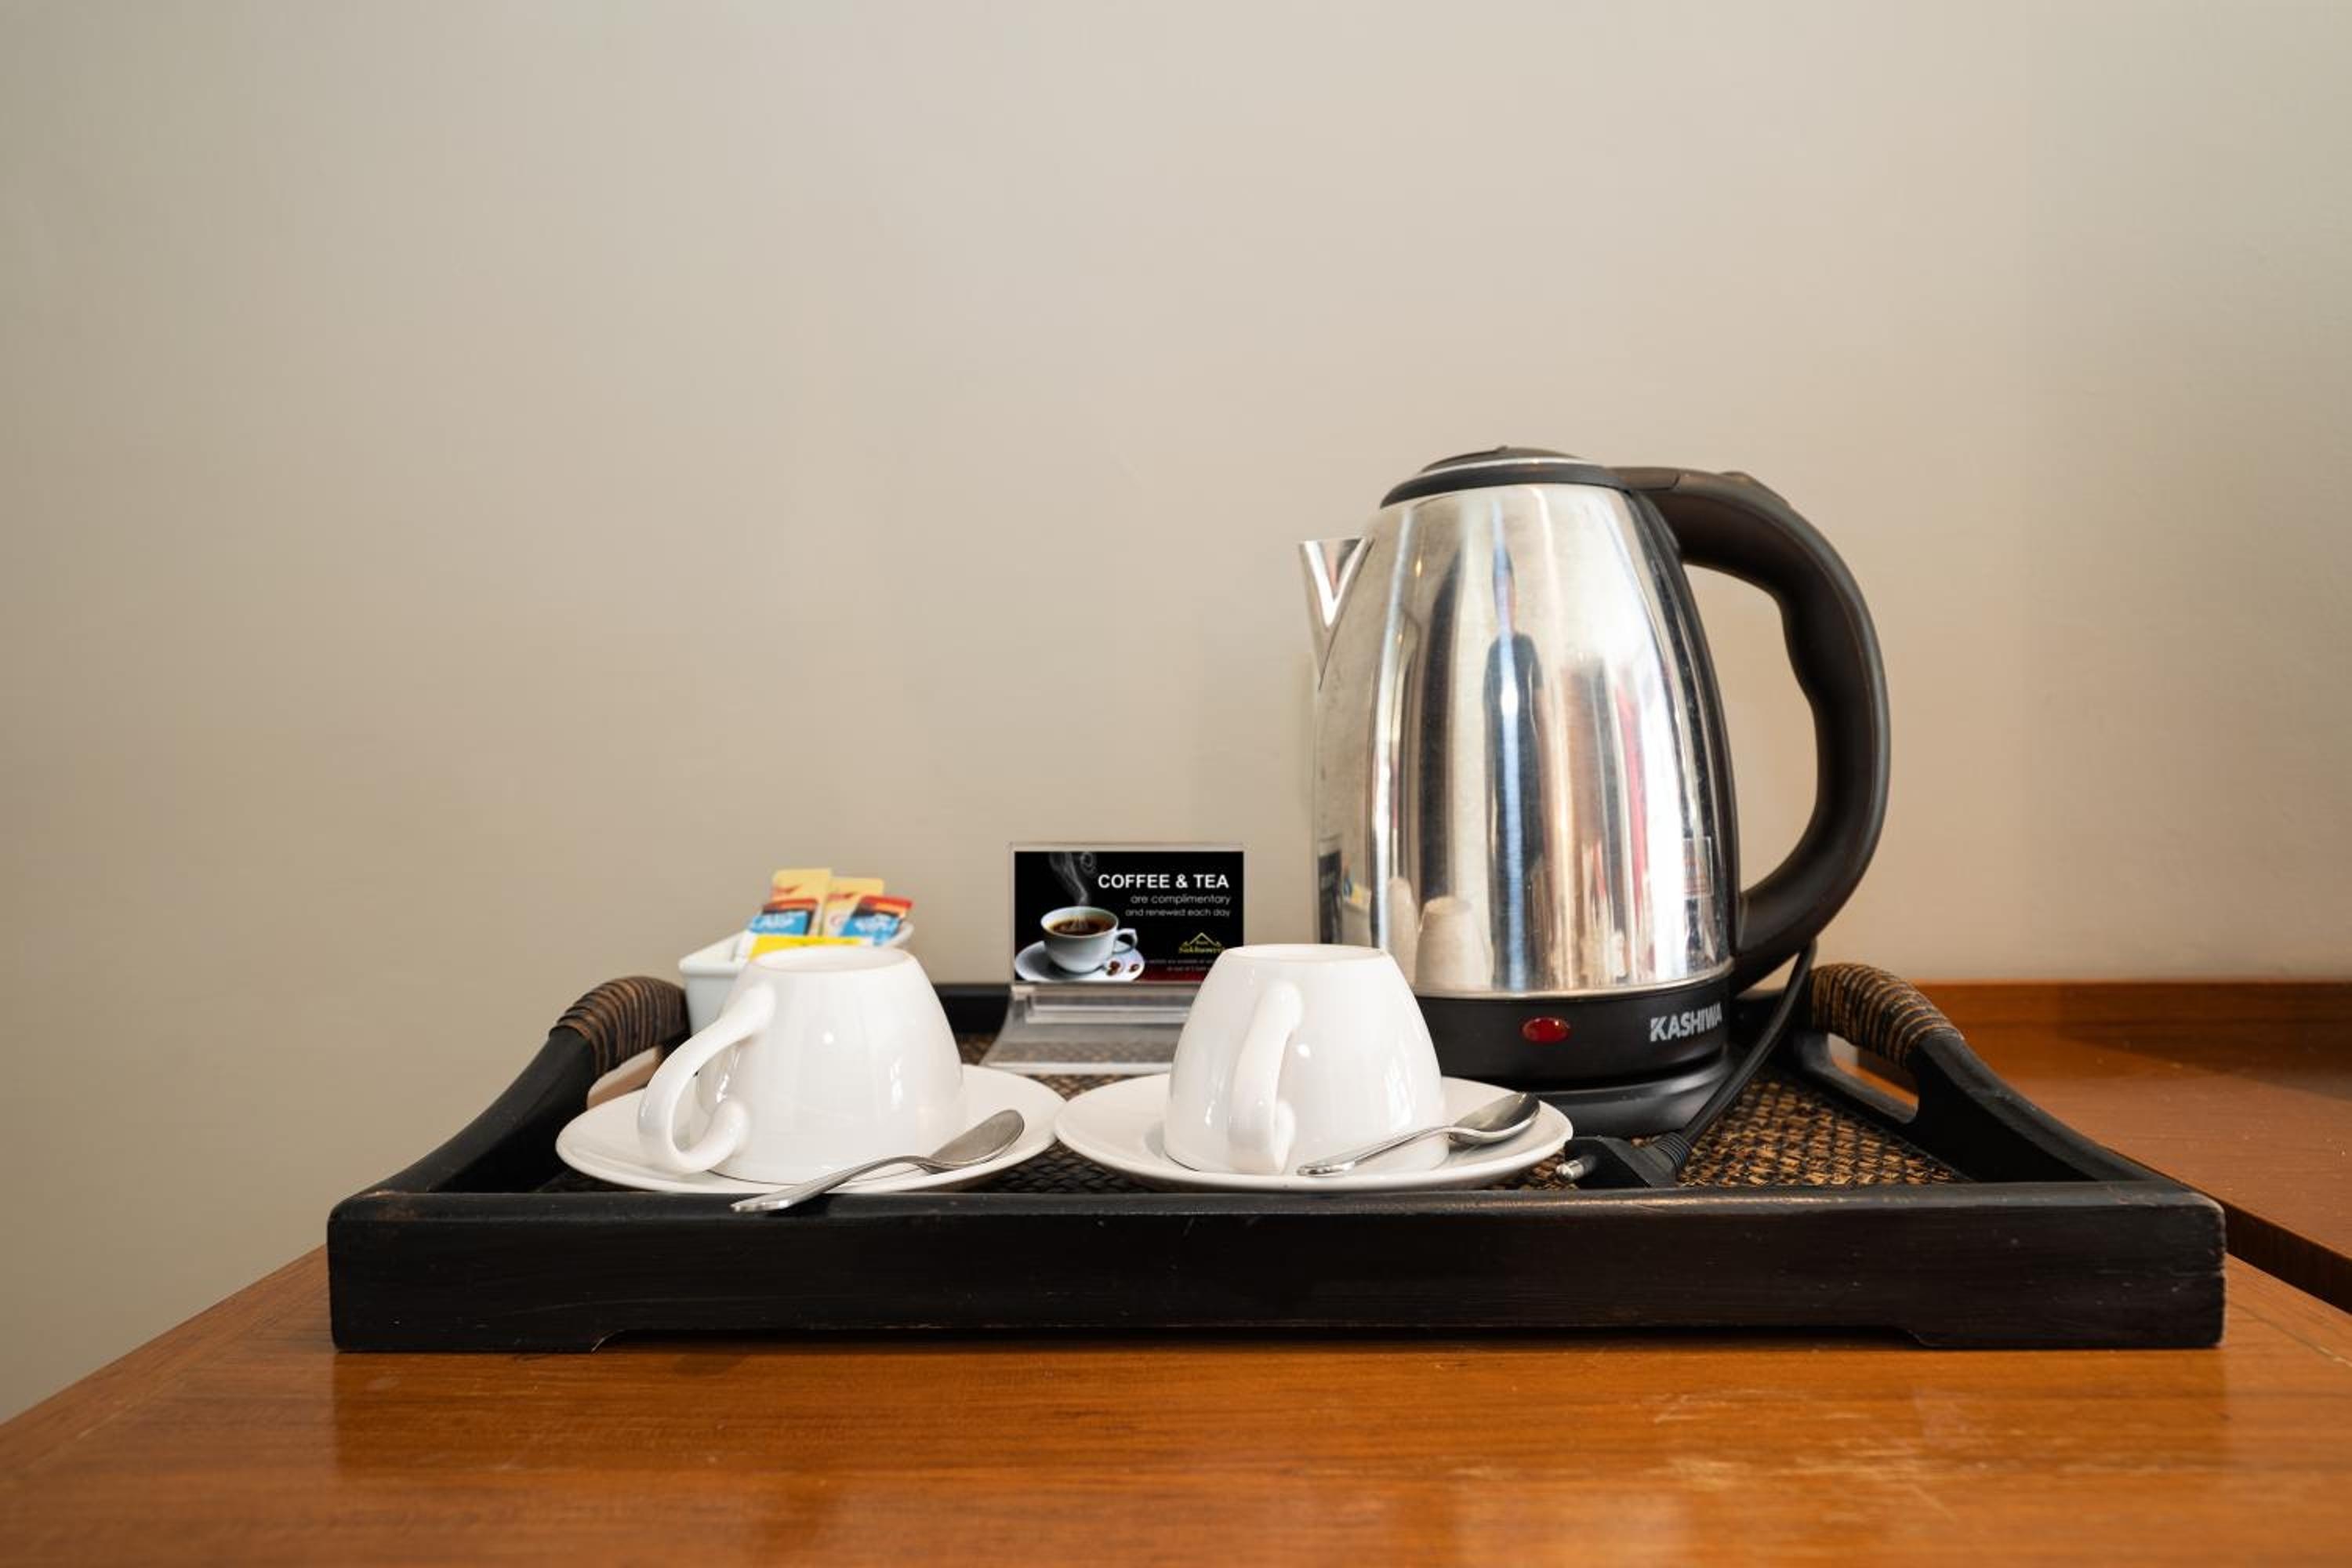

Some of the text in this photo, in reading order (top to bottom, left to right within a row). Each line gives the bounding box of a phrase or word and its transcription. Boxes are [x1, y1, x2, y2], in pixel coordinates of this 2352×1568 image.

[1098, 874, 1229, 888] COFFEE & TEA
[1151, 894, 1230, 905] complimentary
[1125, 908, 1230, 917] and renewed each day
[1650, 1003, 1722, 1042] KASHIWA
